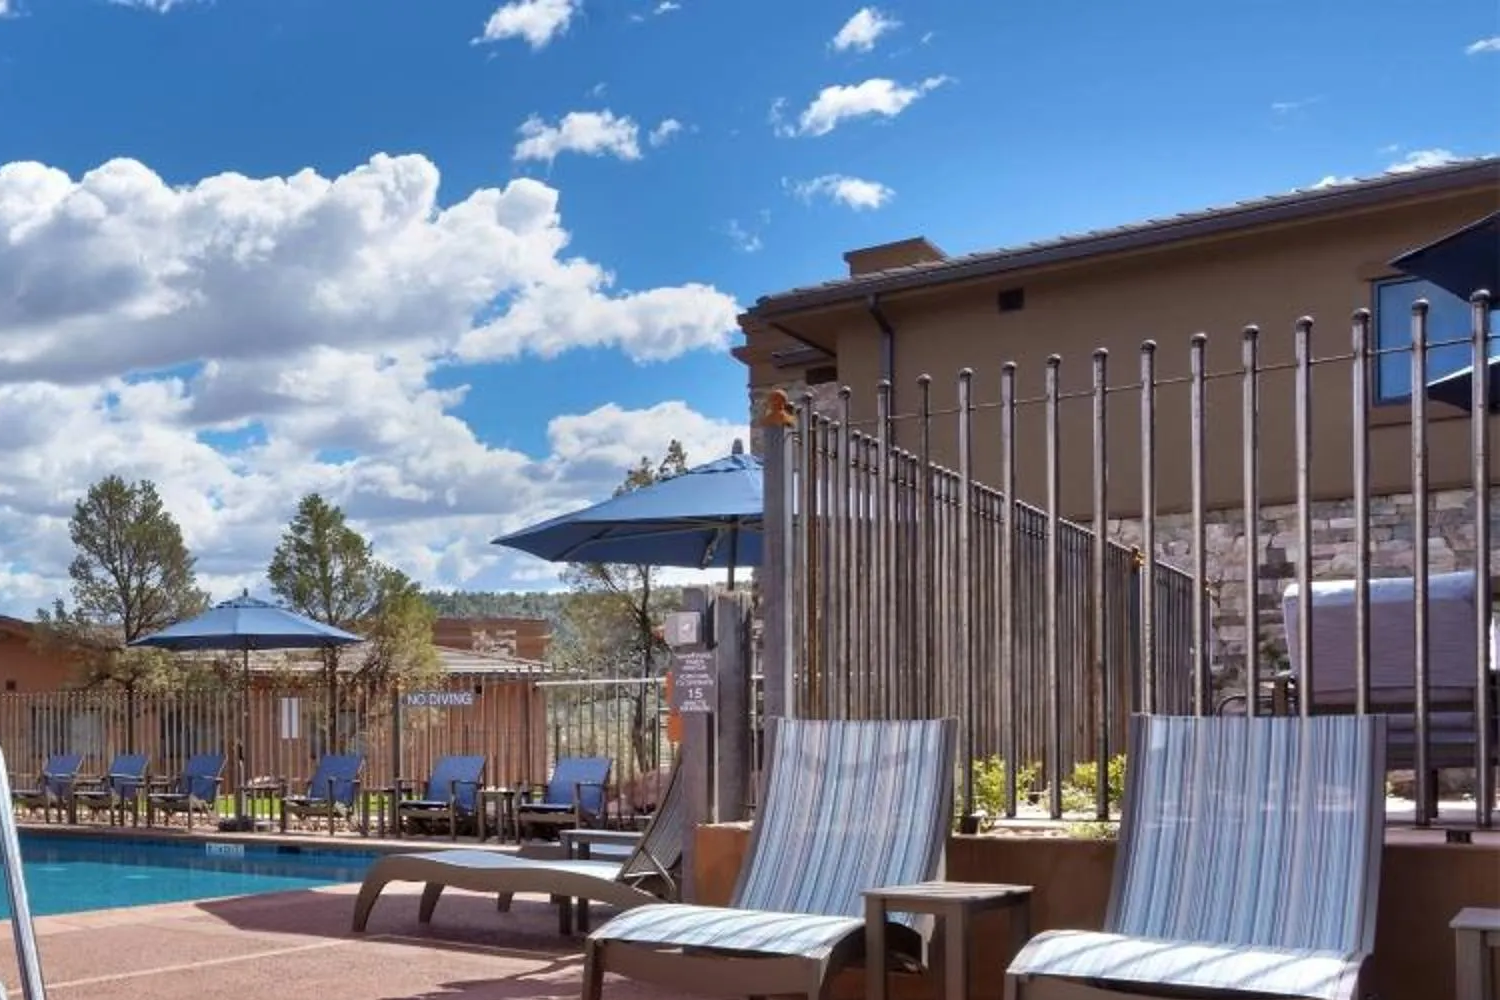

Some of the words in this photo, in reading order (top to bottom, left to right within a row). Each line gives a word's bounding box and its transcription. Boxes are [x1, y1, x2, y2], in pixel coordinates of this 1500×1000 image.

[407, 693, 425, 705] NO
[429, 692, 473, 705] DIVING
[687, 687, 704, 699] 15
